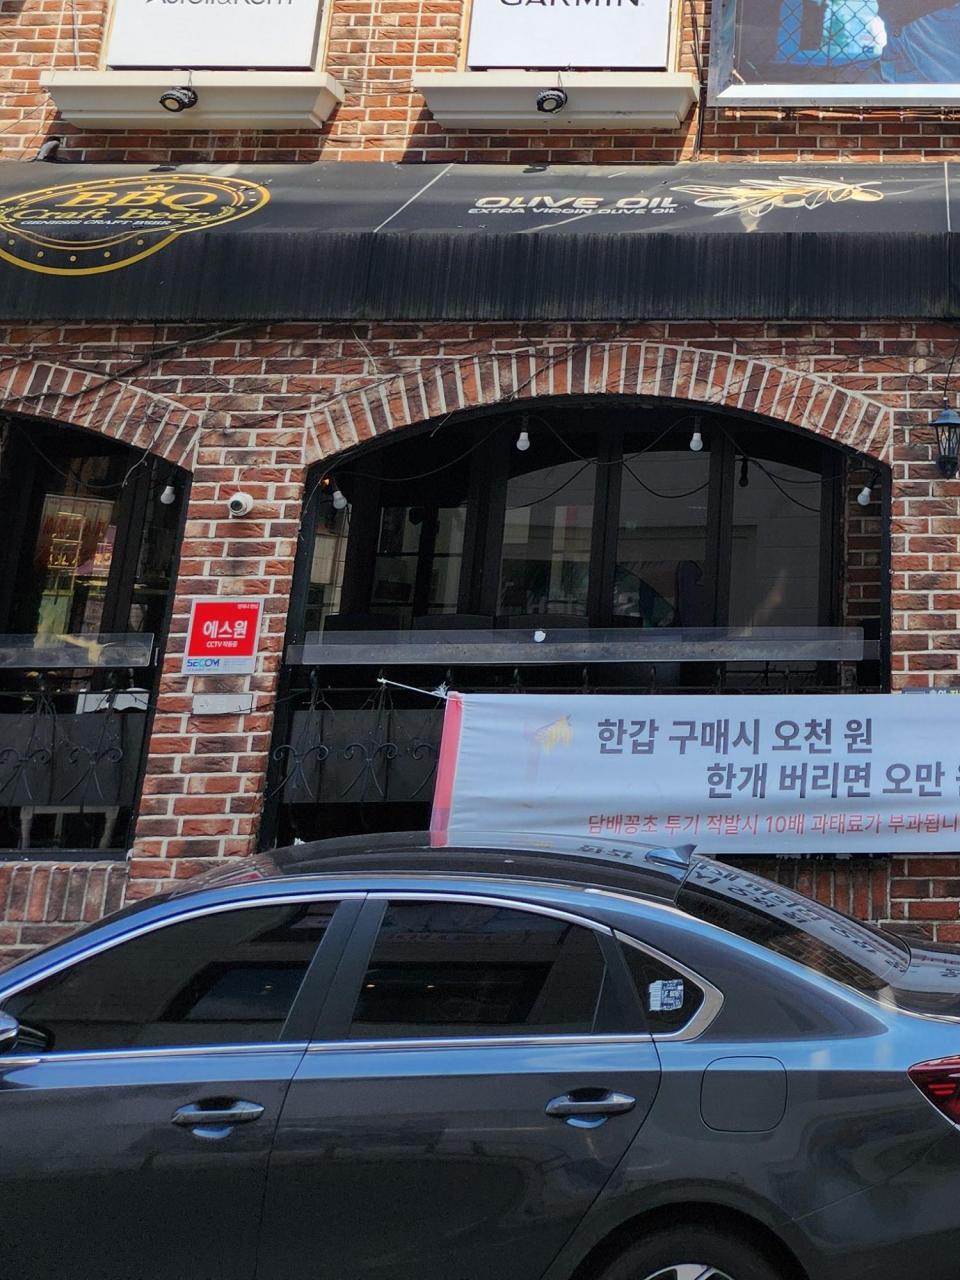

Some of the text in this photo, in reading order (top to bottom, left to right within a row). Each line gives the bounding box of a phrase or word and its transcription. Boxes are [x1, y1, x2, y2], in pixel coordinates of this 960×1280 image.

[55, 191, 218, 211] BBQ
[474, 196, 679, 209] OLIVE OIL
[13, 208, 210, 220] Craft Beer
[203, 620, 248, 638] 에스원
[187, 659, 220, 668] SECOM
[597, 718, 873, 755] 한갑 구매시 오천 원
[706, 762, 766, 799] 한개
[778, 762, 871, 799] 버리면
[882, 761, 945, 798] 오만
[588, 814, 659, 835] 담배꽁초
[665, 814, 700, 835] 투기
[706, 814, 758, 835] 적발시
[765, 814, 805, 834] 10배
[811, 814, 883, 834] 과태료가
